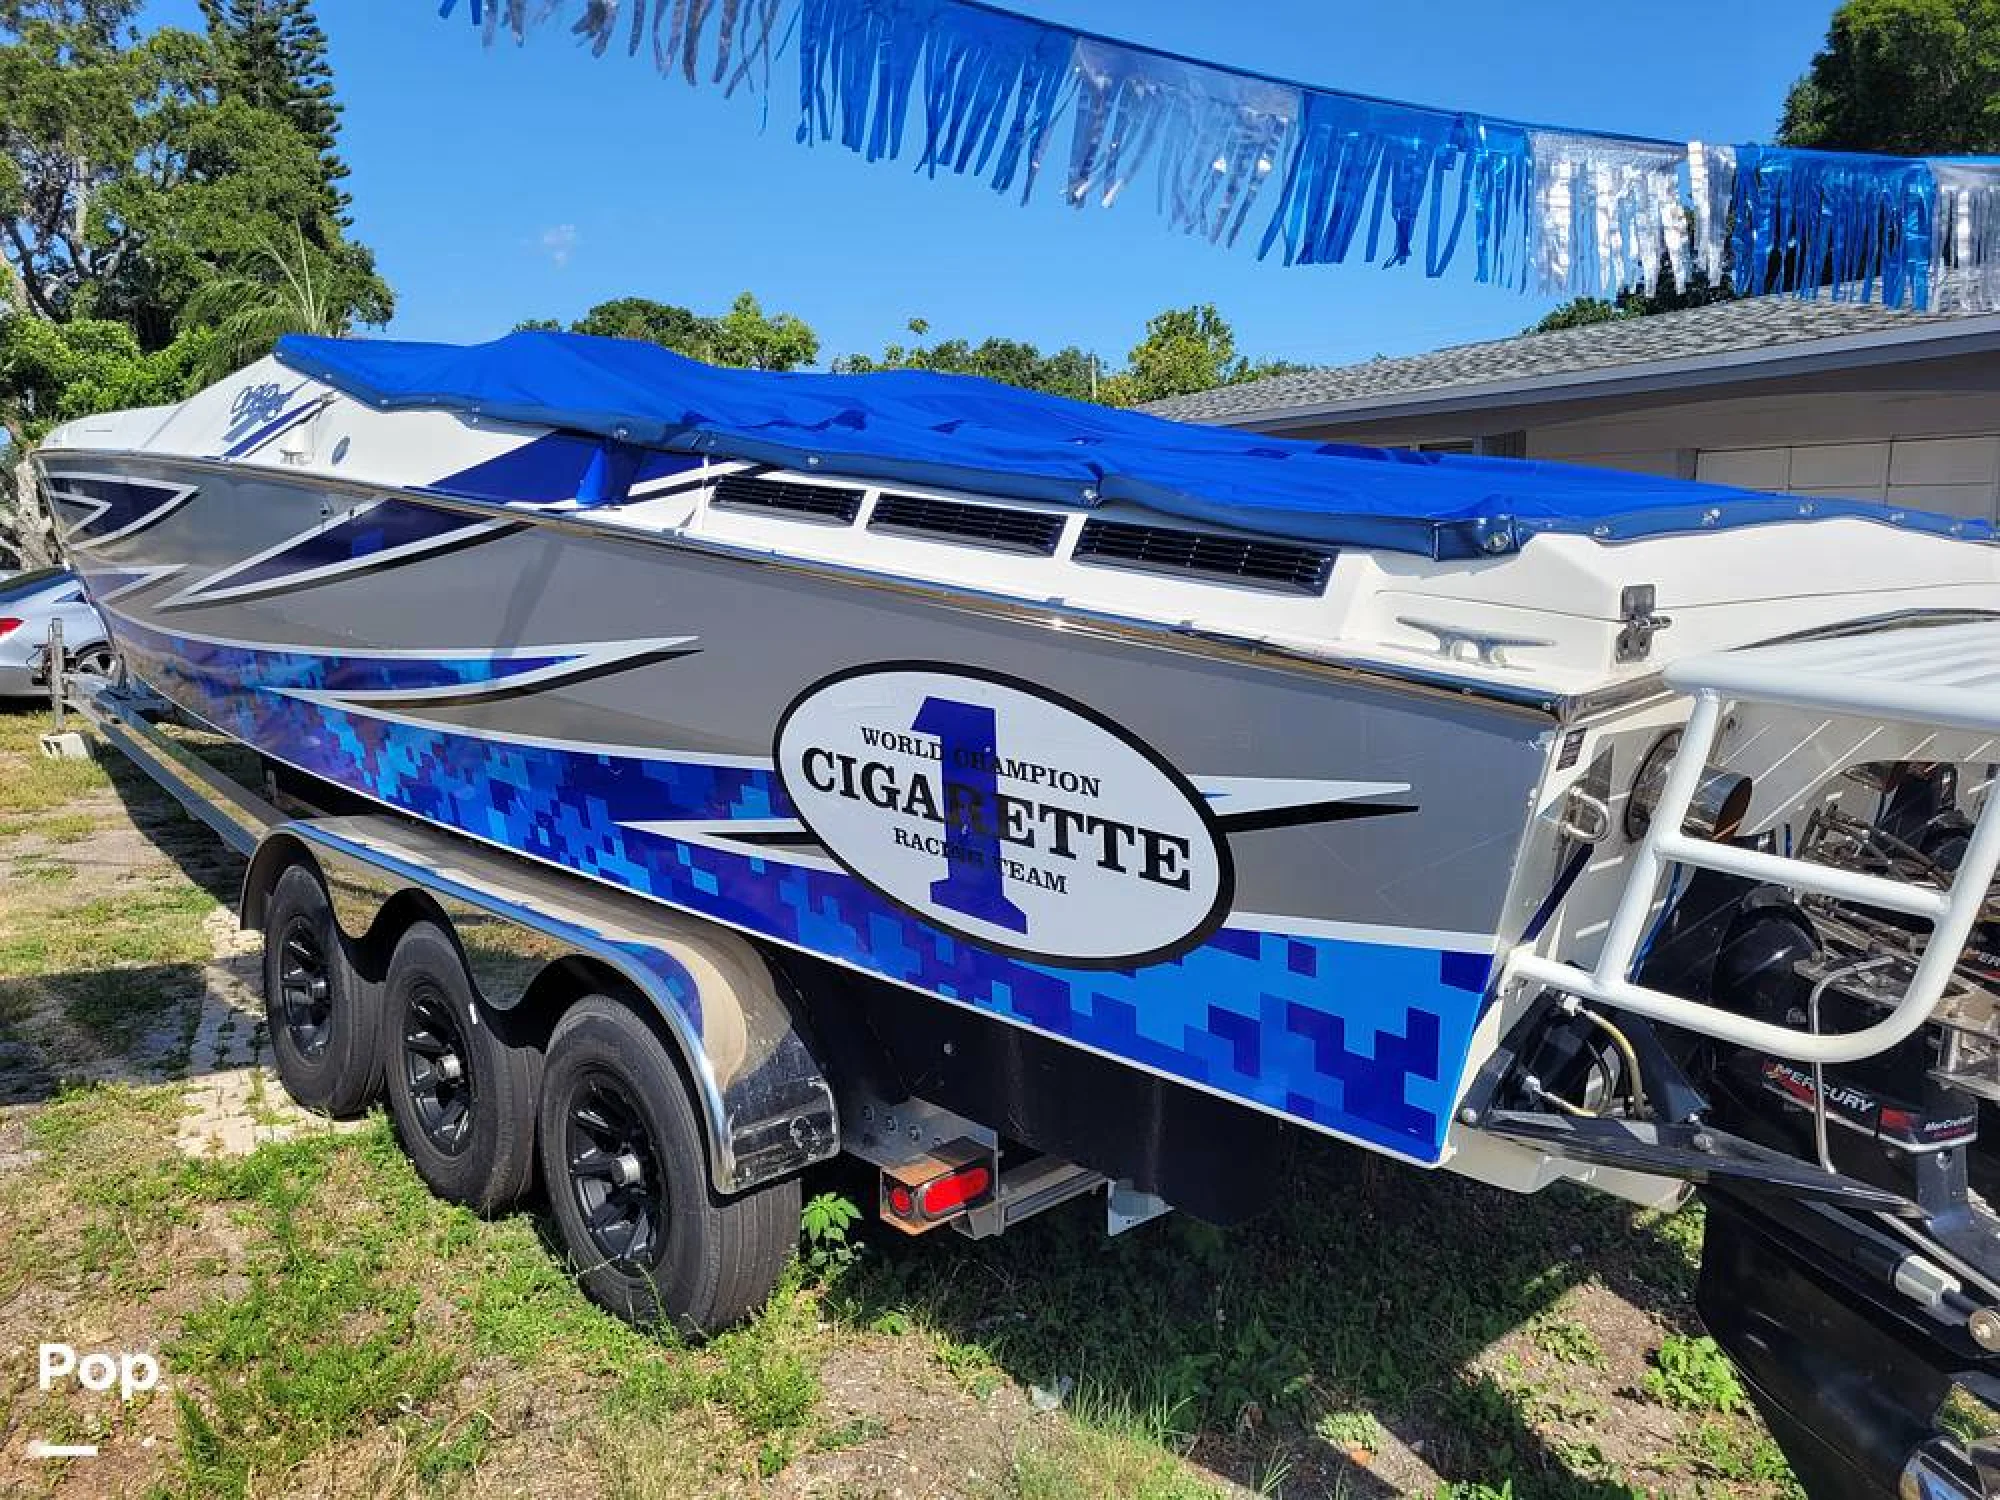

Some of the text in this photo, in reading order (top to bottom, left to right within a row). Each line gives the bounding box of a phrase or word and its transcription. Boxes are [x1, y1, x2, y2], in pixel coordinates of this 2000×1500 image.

[861, 727, 1101, 798] WORLD CHAMPION
[911, 695, 1028, 935] 1
[802, 747, 1191, 891] CIGARETTE
[893, 827, 1069, 895] RACING TEAM
